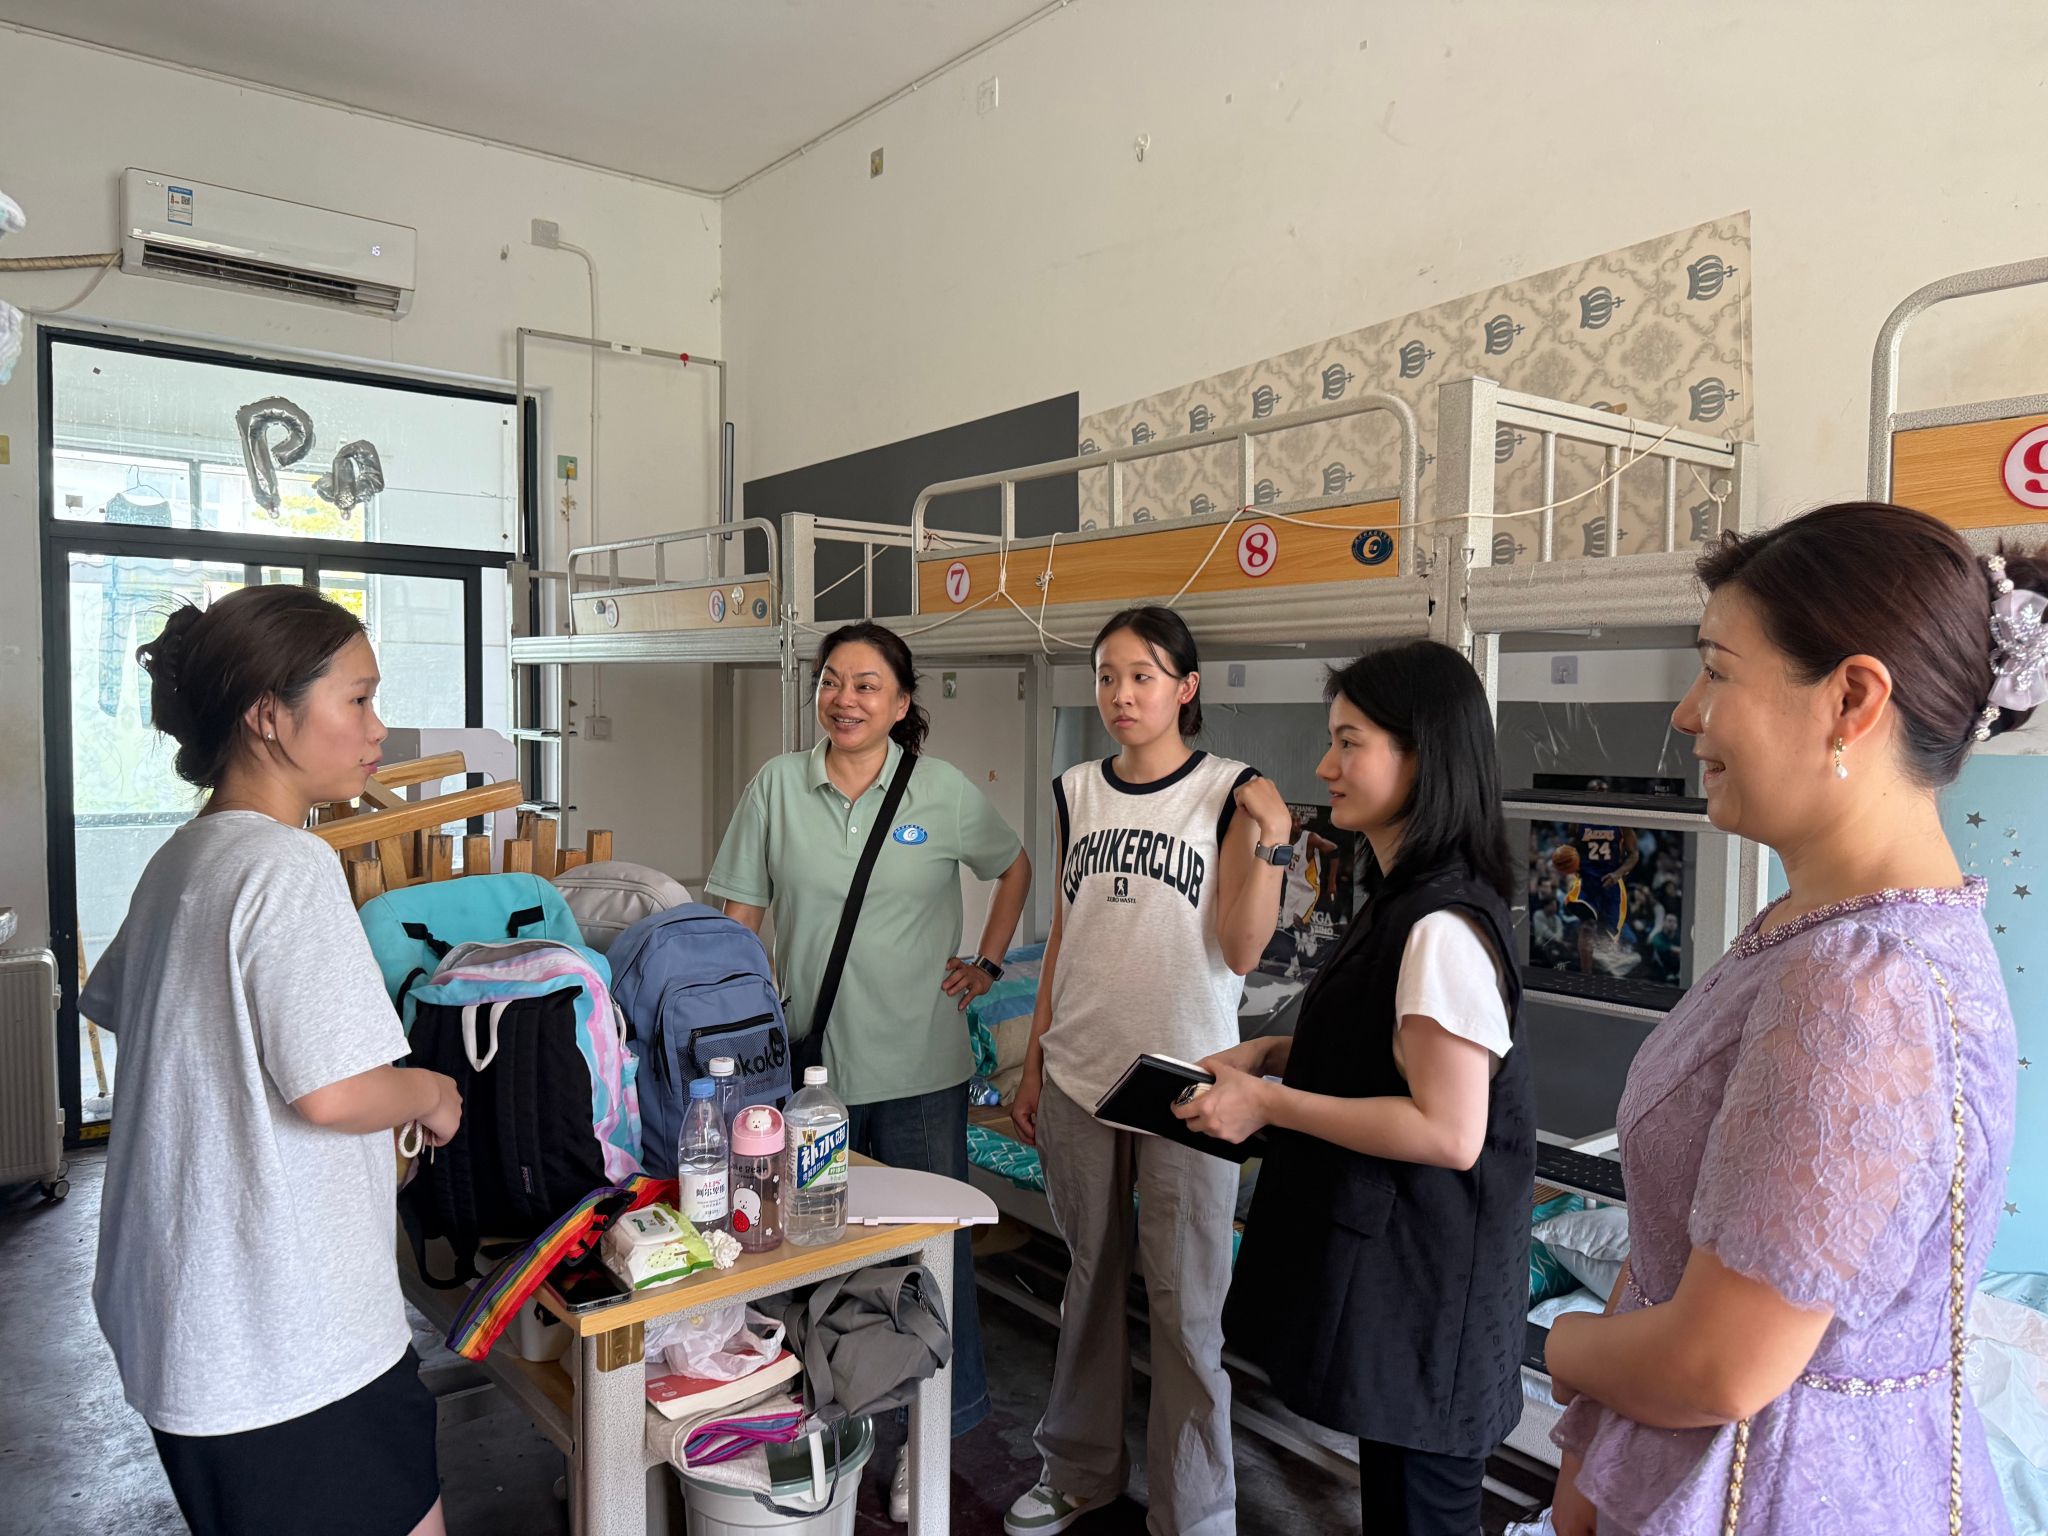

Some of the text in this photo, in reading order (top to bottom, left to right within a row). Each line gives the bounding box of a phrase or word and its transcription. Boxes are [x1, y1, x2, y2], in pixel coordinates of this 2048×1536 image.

[1245, 532, 1269, 567] 8
[949, 568, 966, 597] 7
[1588, 842, 1611, 861] 24
